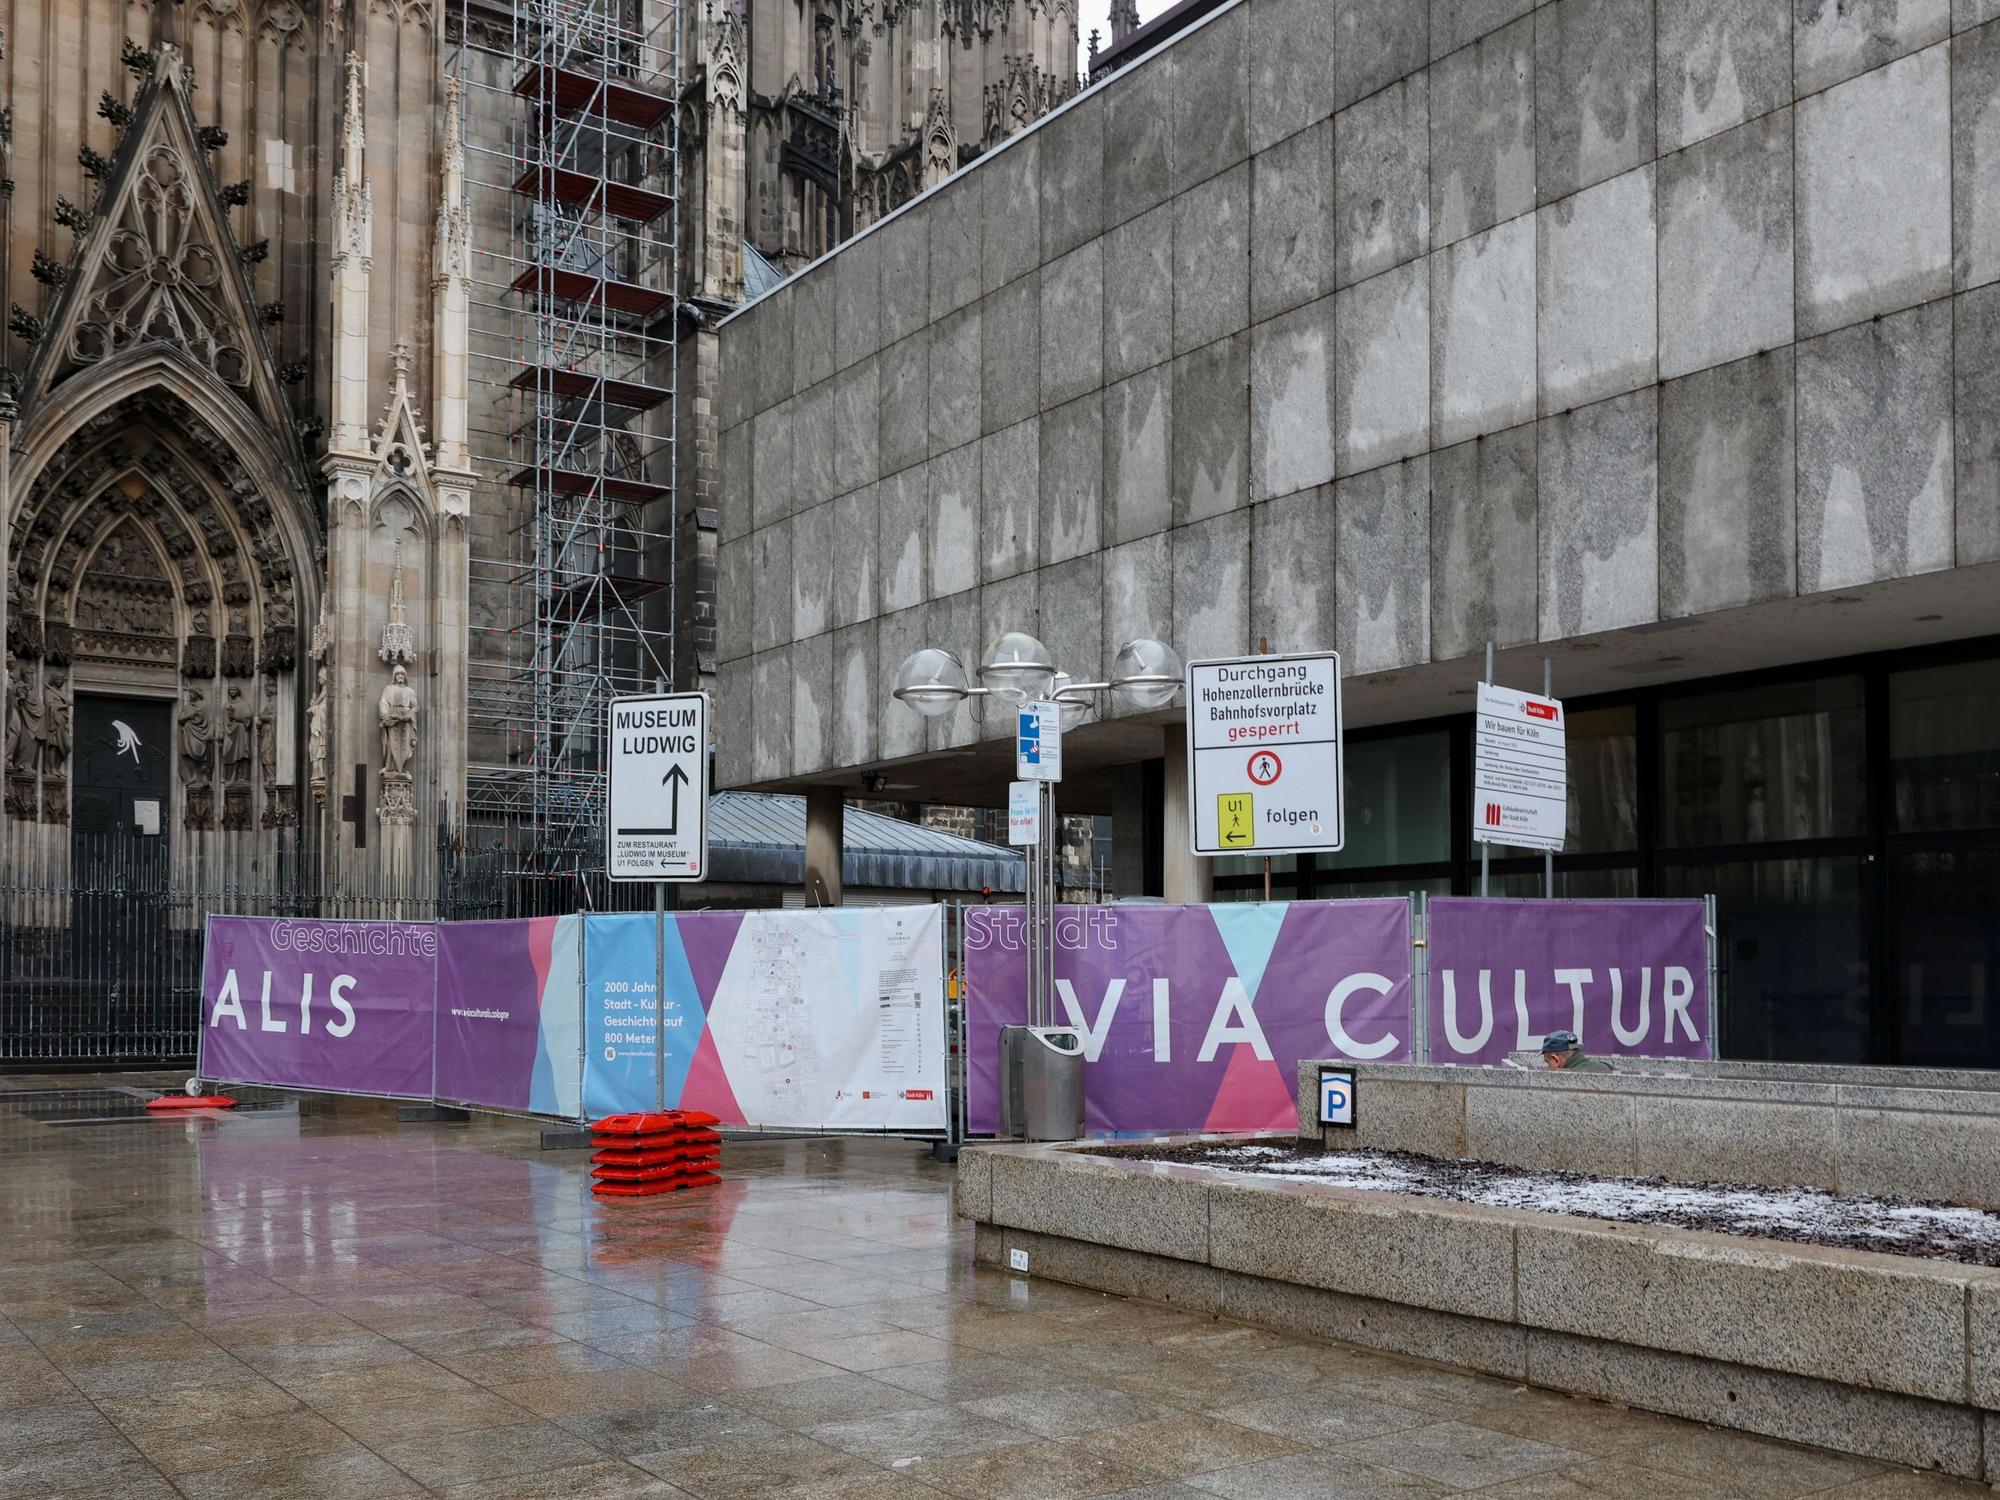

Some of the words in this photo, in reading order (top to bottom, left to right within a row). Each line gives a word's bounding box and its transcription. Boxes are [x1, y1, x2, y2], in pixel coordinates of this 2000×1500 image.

[1218, 665, 1307, 683] Durchgang
[1202, 681, 1324, 702] Hohenzollernbrücke
[617, 709, 696, 729] MUSEUM
[1210, 702, 1317, 721] Bahnhofsvorplatz
[1228, 721, 1300, 742] gesperrt
[1484, 719, 1496, 730] Wir
[1497, 722, 1515, 734] bauen
[1516, 725, 1525, 736] für
[1526, 727, 1539, 738] Köln
[623, 735, 696, 755] LUDWIG
[1228, 800, 1242, 812] U1
[1266, 808, 1318, 826] folgen
[617, 841, 632, 849] ZUM
[633, 841, 678, 849] RESTAURANT
[648, 850, 656, 858] IM
[964, 905, 1118, 950] Stdt
[270, 918, 437, 957] Geschichte
[604, 982, 628, 993] 2000
[210, 968, 358, 1038] ALIS
[663, 1015, 684, 1027] auf
[1054, 976, 1276, 1063] VIA
[604, 1032, 622, 1044] 800
[1327, 1090, 1346, 1119] P
